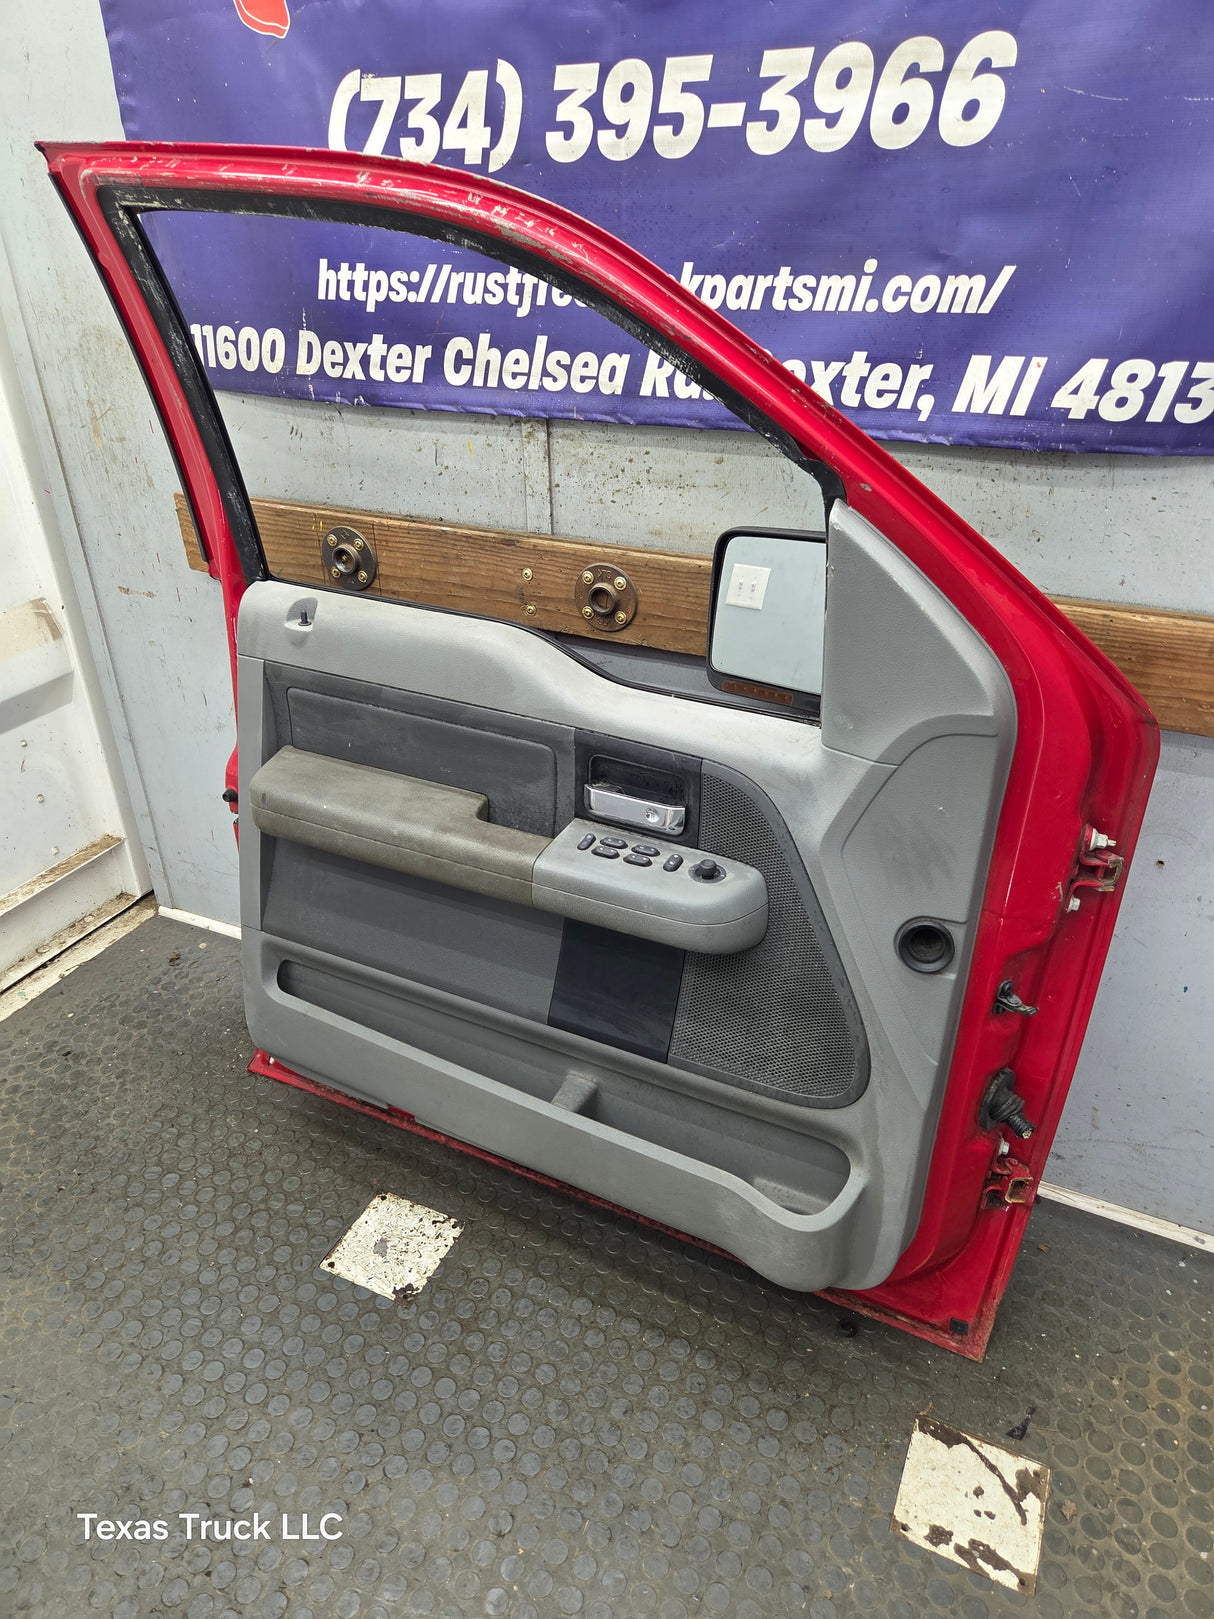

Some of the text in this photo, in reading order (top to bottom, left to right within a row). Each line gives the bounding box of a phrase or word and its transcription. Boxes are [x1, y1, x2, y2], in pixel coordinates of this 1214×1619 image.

[328, 31, 1017, 173] (734) 395-3966
[190, 324, 285, 373] 11600
[296, 330, 432, 383] Dexter
[444, 334, 630, 395] Chelsea
[763, 349, 934, 421] xter,
[952, 355, 1048, 416] MI
